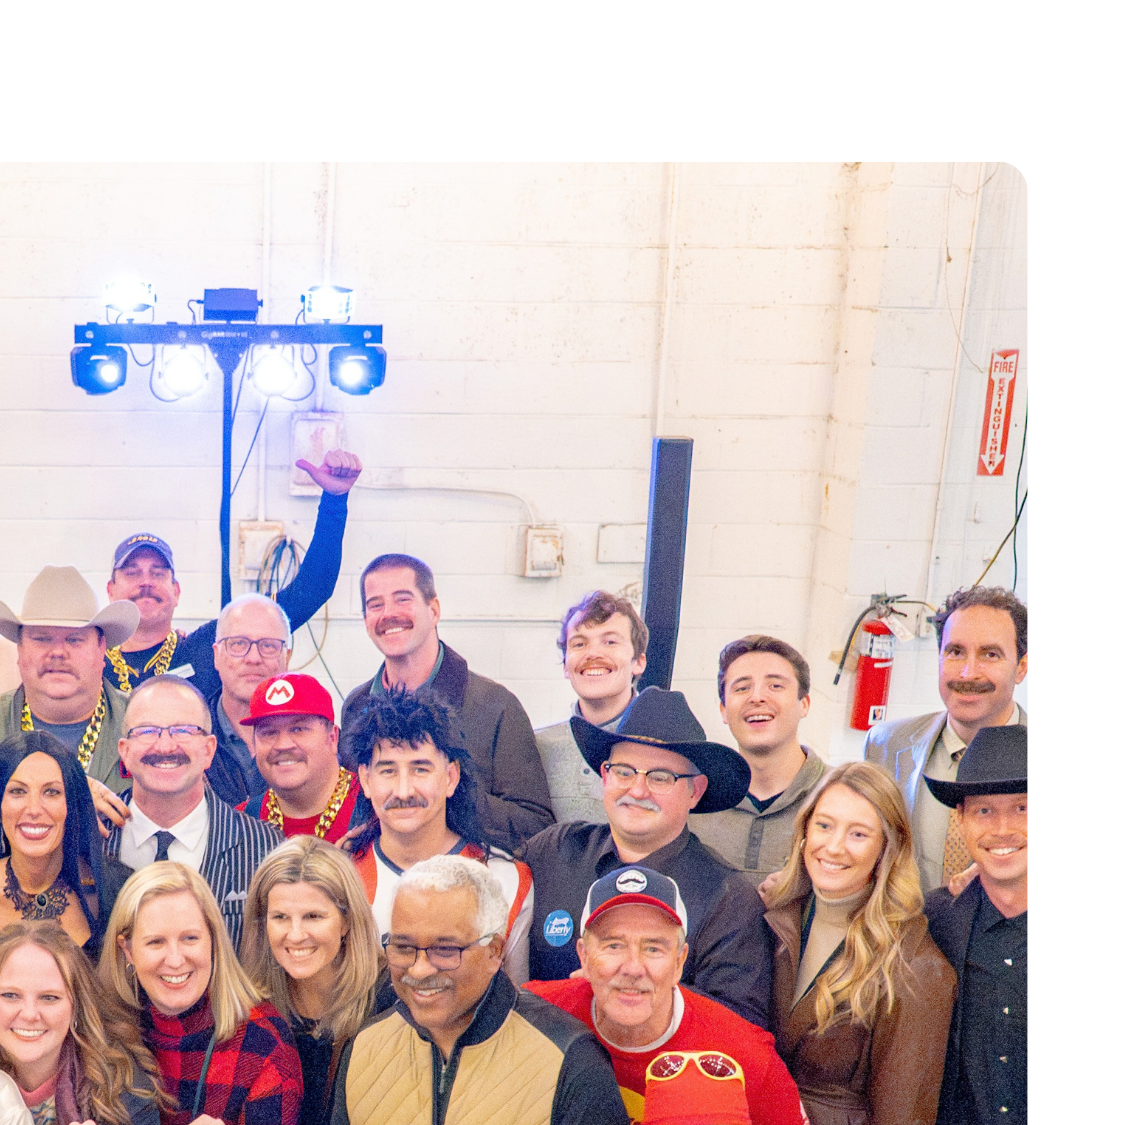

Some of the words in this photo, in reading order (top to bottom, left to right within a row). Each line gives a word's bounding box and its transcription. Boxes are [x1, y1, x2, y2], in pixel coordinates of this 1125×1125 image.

[993, 361, 1014, 373] FIRE
[988, 378, 1005, 467] EXTINGUISHER
[267, 686, 290, 700] M
